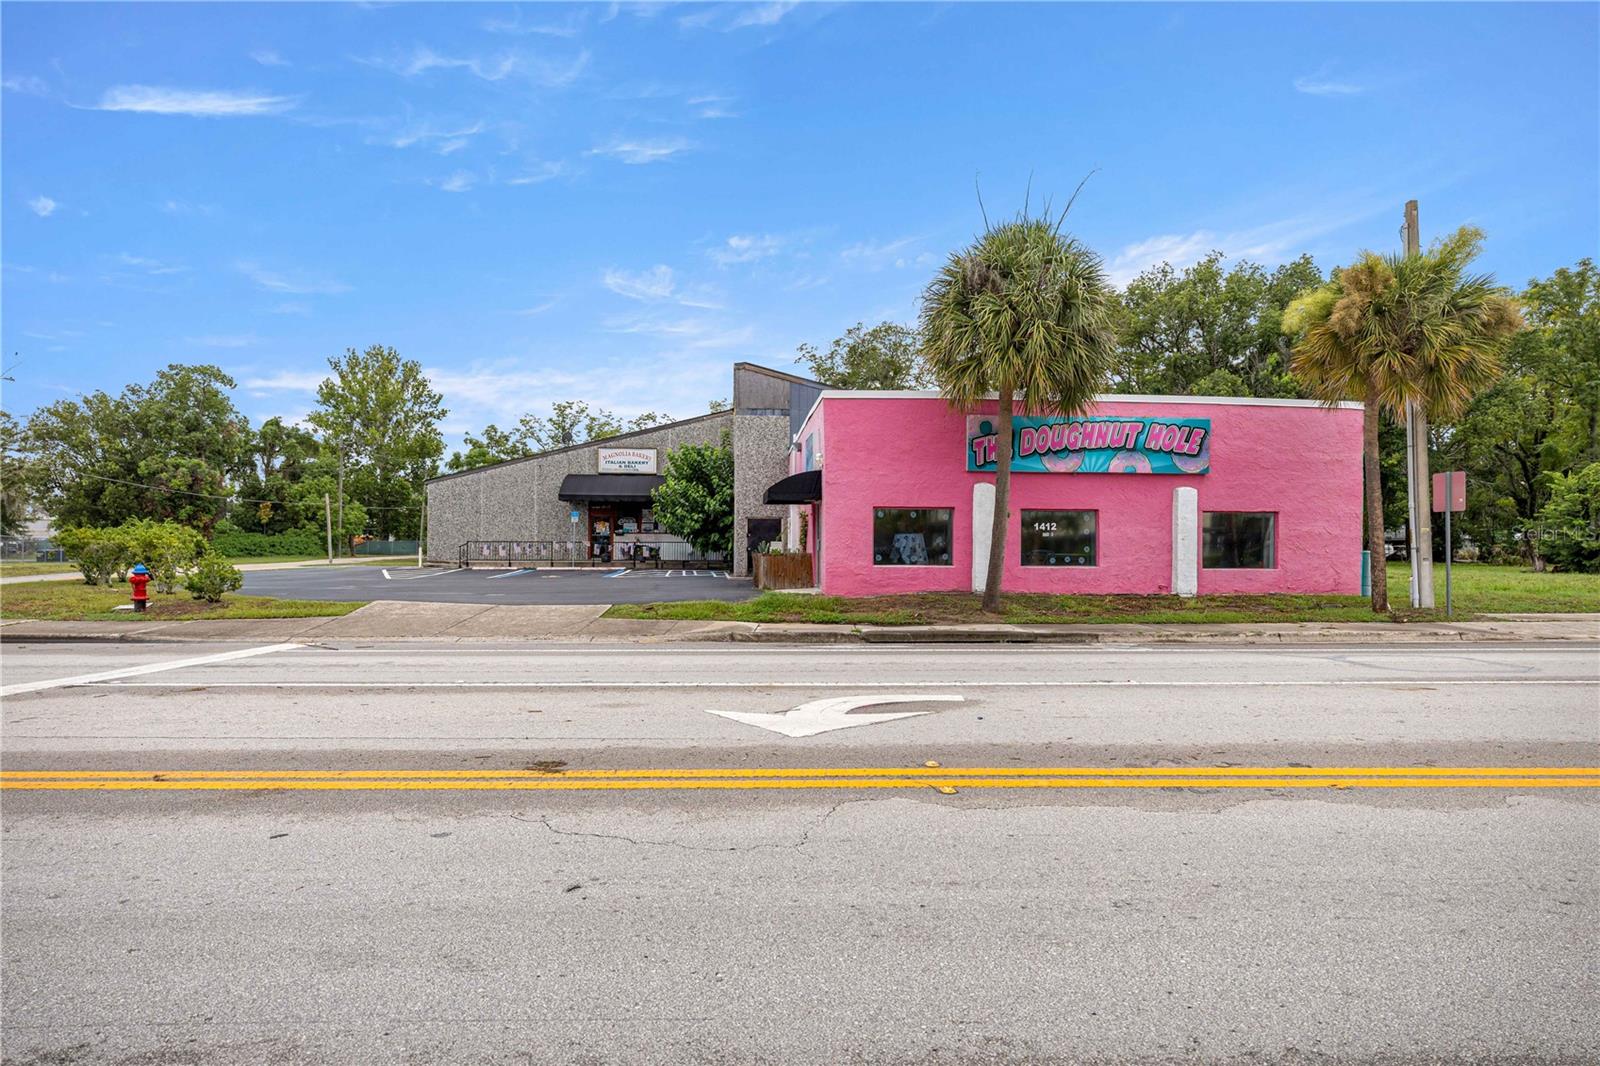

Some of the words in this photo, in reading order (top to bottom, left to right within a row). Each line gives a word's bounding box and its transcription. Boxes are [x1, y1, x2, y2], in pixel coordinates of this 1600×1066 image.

[972, 433, 1013, 467] TH
[1020, 420, 1144, 457] DOUGHNUT
[1145, 423, 1207, 455] HOLE
[602, 451, 631, 460] MAGNOLIA
[632, 451, 652, 460] BAKERY
[1033, 522, 1057, 531] 1412
